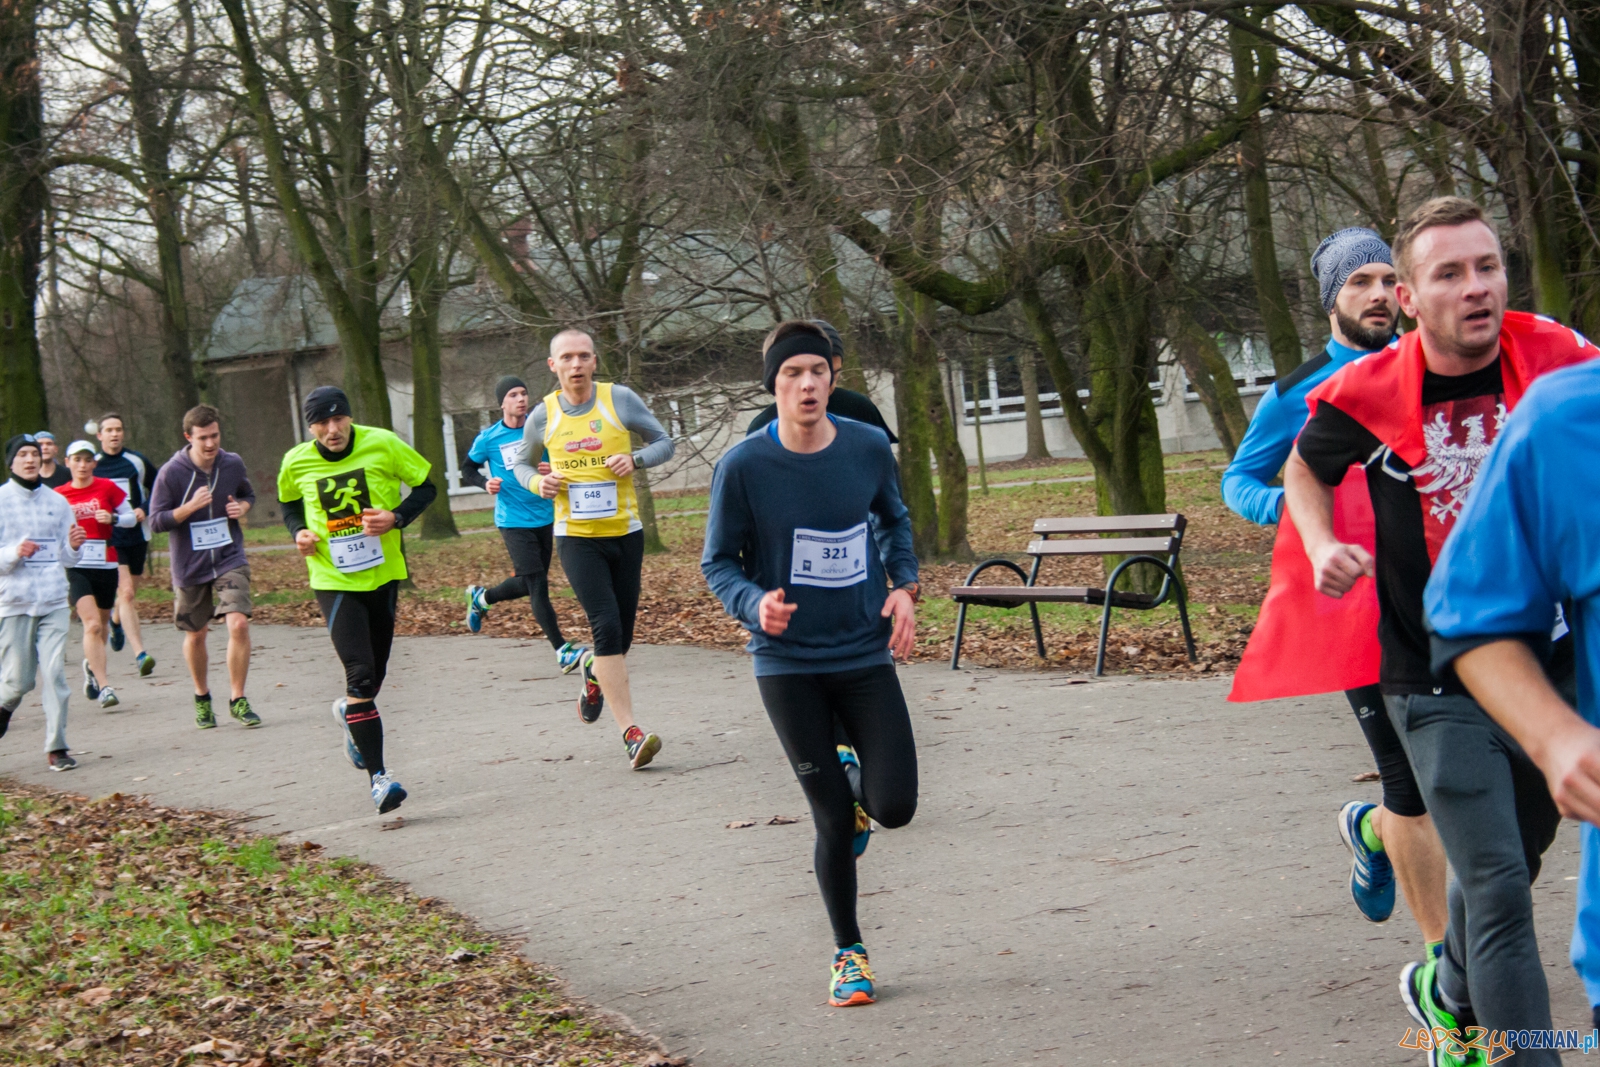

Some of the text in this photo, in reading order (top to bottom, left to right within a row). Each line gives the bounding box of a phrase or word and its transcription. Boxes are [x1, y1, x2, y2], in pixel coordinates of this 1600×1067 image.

[584, 490, 601, 499] 648
[347, 541, 365, 553] 514
[822, 546, 849, 559] 321
